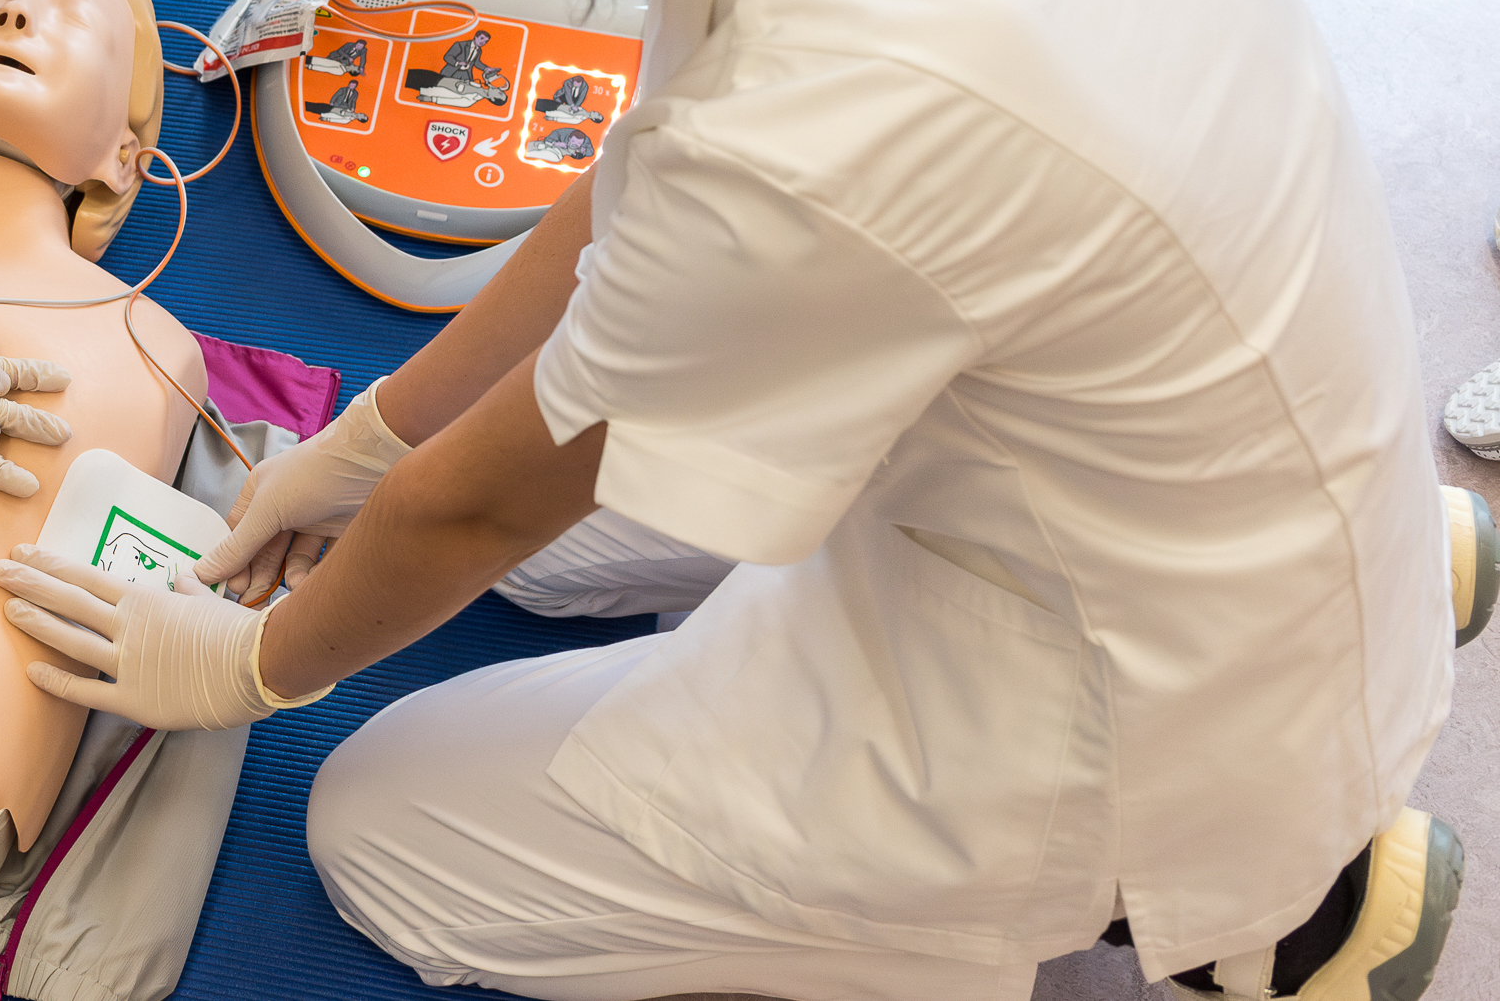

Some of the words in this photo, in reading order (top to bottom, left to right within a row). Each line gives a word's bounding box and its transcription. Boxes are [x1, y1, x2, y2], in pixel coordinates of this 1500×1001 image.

[592, 85, 604, 96] 30
[430, 124, 467, 137] SHOCK
[532, 122, 538, 131] 2
